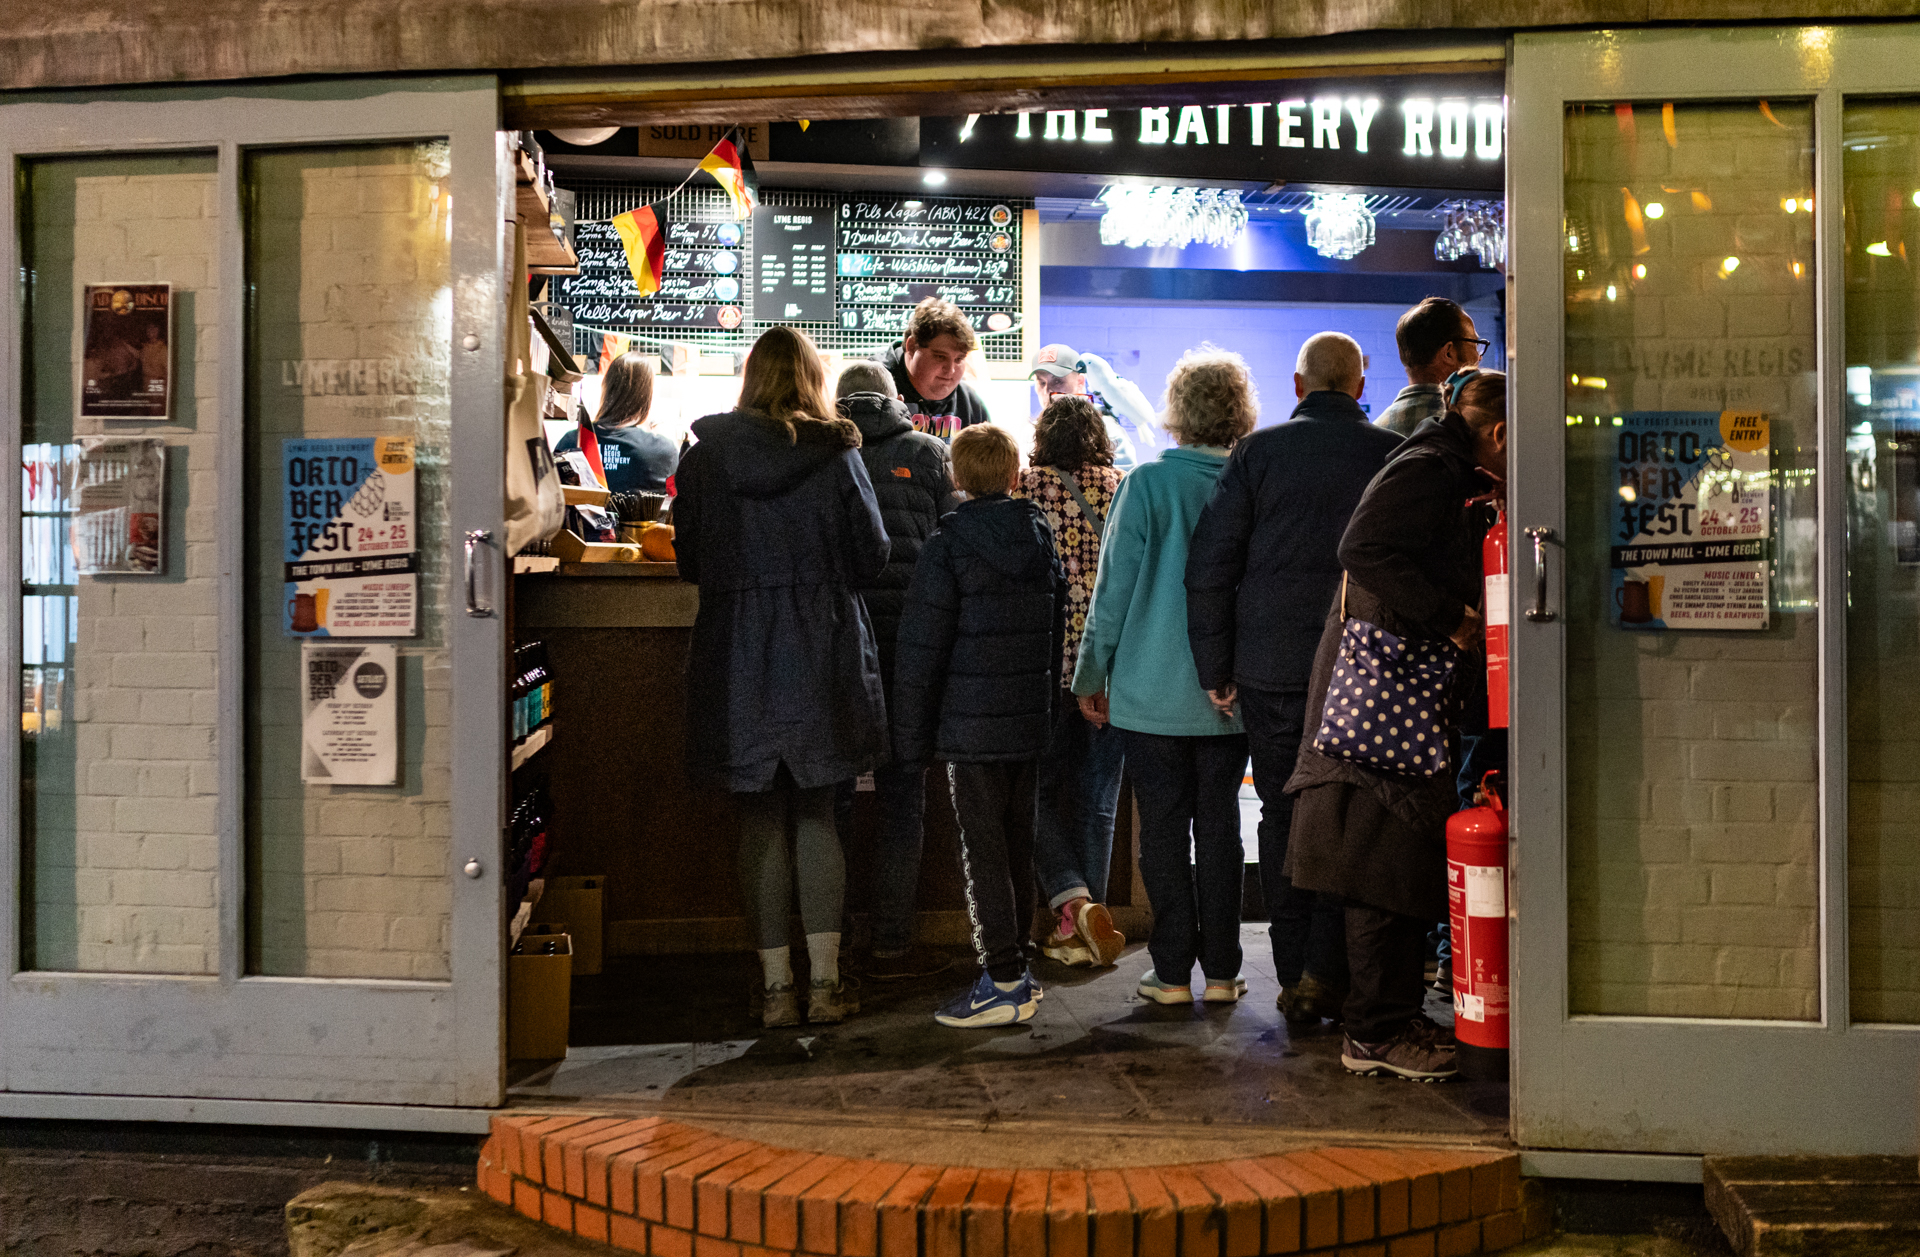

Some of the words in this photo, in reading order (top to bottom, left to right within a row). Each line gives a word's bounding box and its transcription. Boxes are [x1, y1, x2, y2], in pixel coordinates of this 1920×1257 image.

[650, 125, 701, 140] SOLD
[1139, 98, 1379, 151] BATTERY
[773, 215, 792, 224] LYME
[792, 215, 813, 225] REGIS
[842, 203, 850, 218] 6
[854, 202, 881, 219] Pils
[884, 201, 926, 221] Lager
[928, 204, 963, 223] (ABK)
[577, 232, 602, 241] Lyme
[701, 224, 718, 241] 5%
[842, 230, 850, 245] 7
[851, 229, 891, 246] Dunkel
[891, 230, 921, 247] Dark
[921, 230, 952, 247] Lager
[949, 231, 974, 248] Beer
[974, 232, 991, 248] 5%
[579, 259, 604, 268] Lyme
[842, 258, 850, 273] 8
[562, 278, 571, 292] 4
[570, 275, 604, 291] Long
[570, 286, 596, 295] Lyme
[600, 287, 619, 297] Regis
[842, 284, 851, 300] 9
[888, 283, 910, 295] Red
[985, 287, 1014, 303] 4.5%
[572, 303, 612, 322] Hells
[611, 303, 652, 323] Lager
[651, 304, 682, 322] Beer
[683, 305, 706, 320] 5%
[842, 312, 857, 327] 10
[1644, 417, 1670, 427] REGIS
[1673, 416, 1714, 427] BREWERY
[1733, 416, 1758, 427] FREE
[1729, 430, 1763, 441] ENTRY
[1618, 431, 1700, 464] OKTO
[603, 456, 631, 464] BREWERY
[289, 456, 358, 488] OKTO
[1619, 466, 1683, 500] BER
[290, 489, 344, 520] BER
[1619, 502, 1696, 541] FEST
[1700, 509, 1719, 525] 24
[1739, 507, 1760, 524] 25
[357, 528, 374, 542] 24
[390, 524, 407, 540] 25
[1701, 525, 1738, 536] OCTOBER
[1740, 524, 1762, 534] 2025
[290, 521, 354, 558] FEST
[358, 541, 389, 551] OCTOBER
[1621, 550, 1638, 561] THE
[1641, 548, 1669, 560] TOWN
[1671, 547, 1694, 559] MILL
[1705, 545, 1730, 557] LYME
[1732, 543, 1761, 555] REGIS
[292, 566, 308, 576] THE
[309, 563, 333, 575] TOWN
[334, 562, 354, 573] MILL
[362, 560, 383, 571] LYME
[1704, 571, 1730, 580] MUSIC
[1670, 611, 1692, 619] BEERS,
[1724, 611, 1764, 619] BRATWURST
